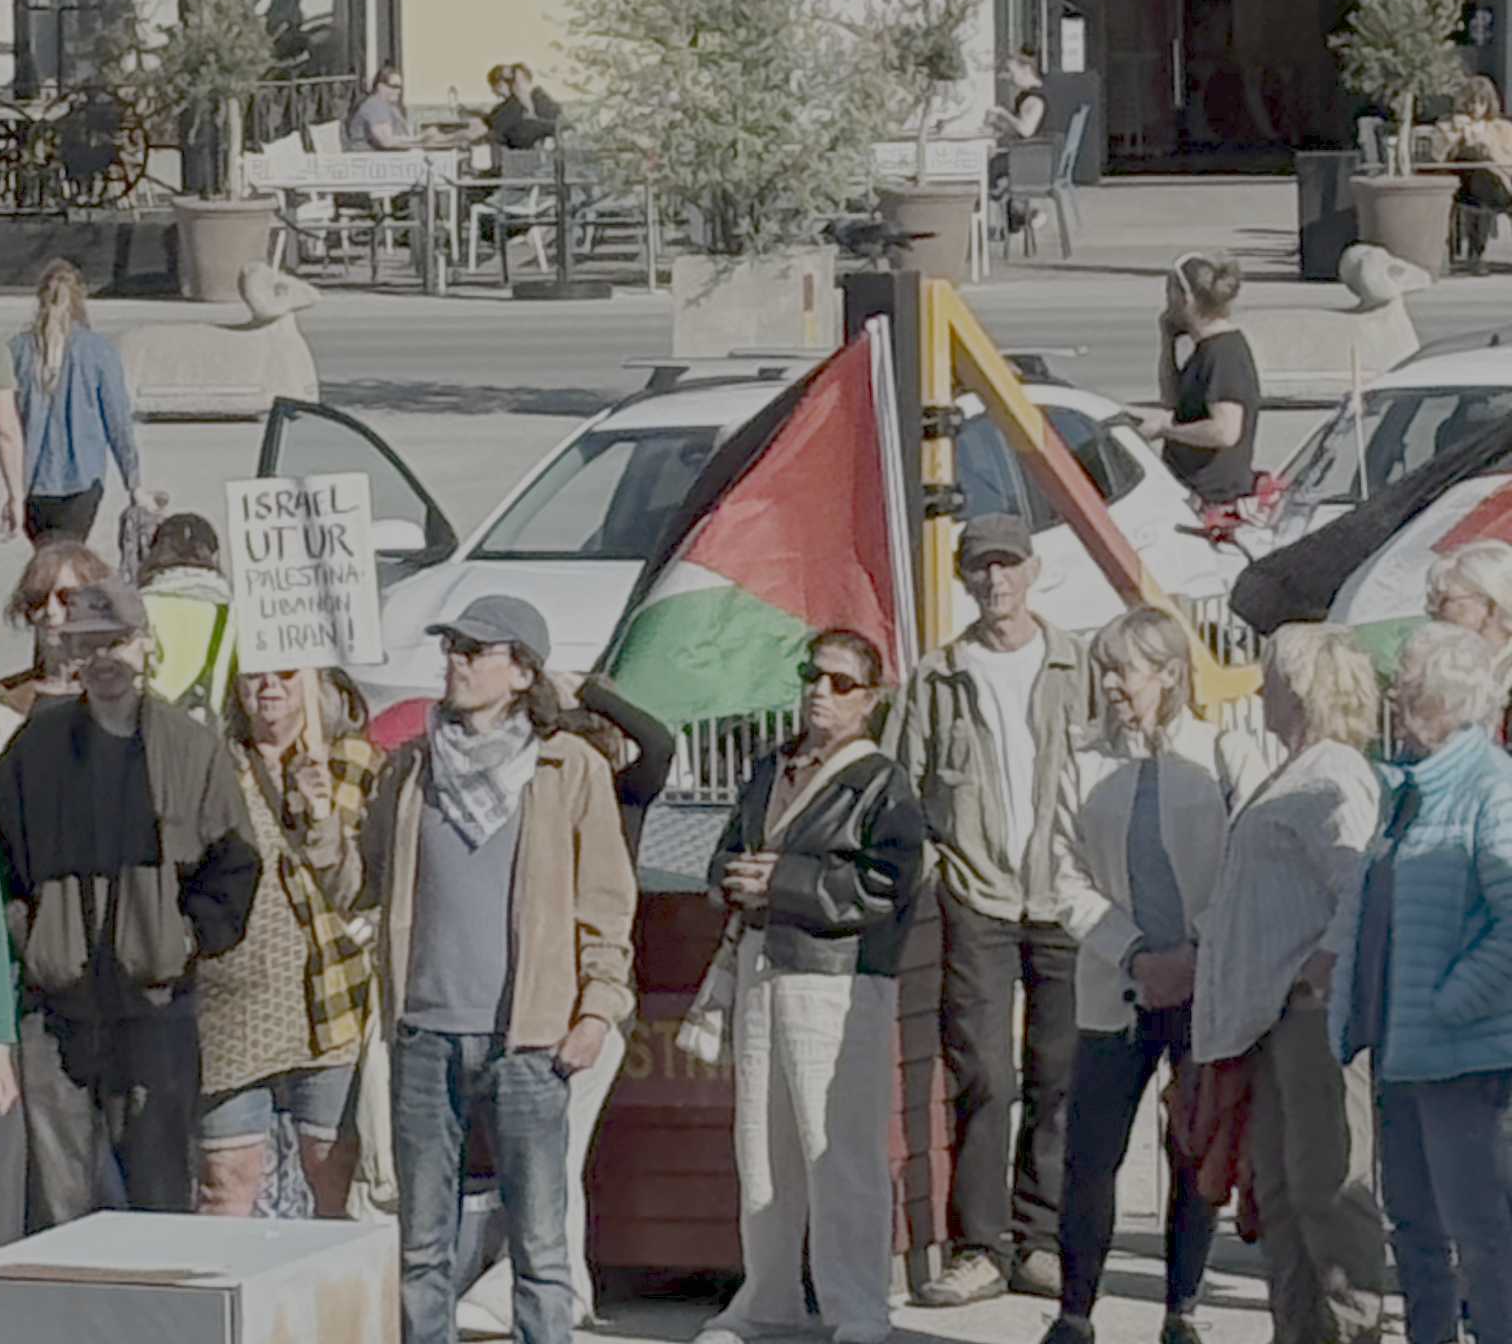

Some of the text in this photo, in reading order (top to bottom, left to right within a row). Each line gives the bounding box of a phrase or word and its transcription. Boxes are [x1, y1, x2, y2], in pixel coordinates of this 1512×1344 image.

[242, 484, 361, 522] ISRAEL
[245, 523, 355, 563] UT UR
